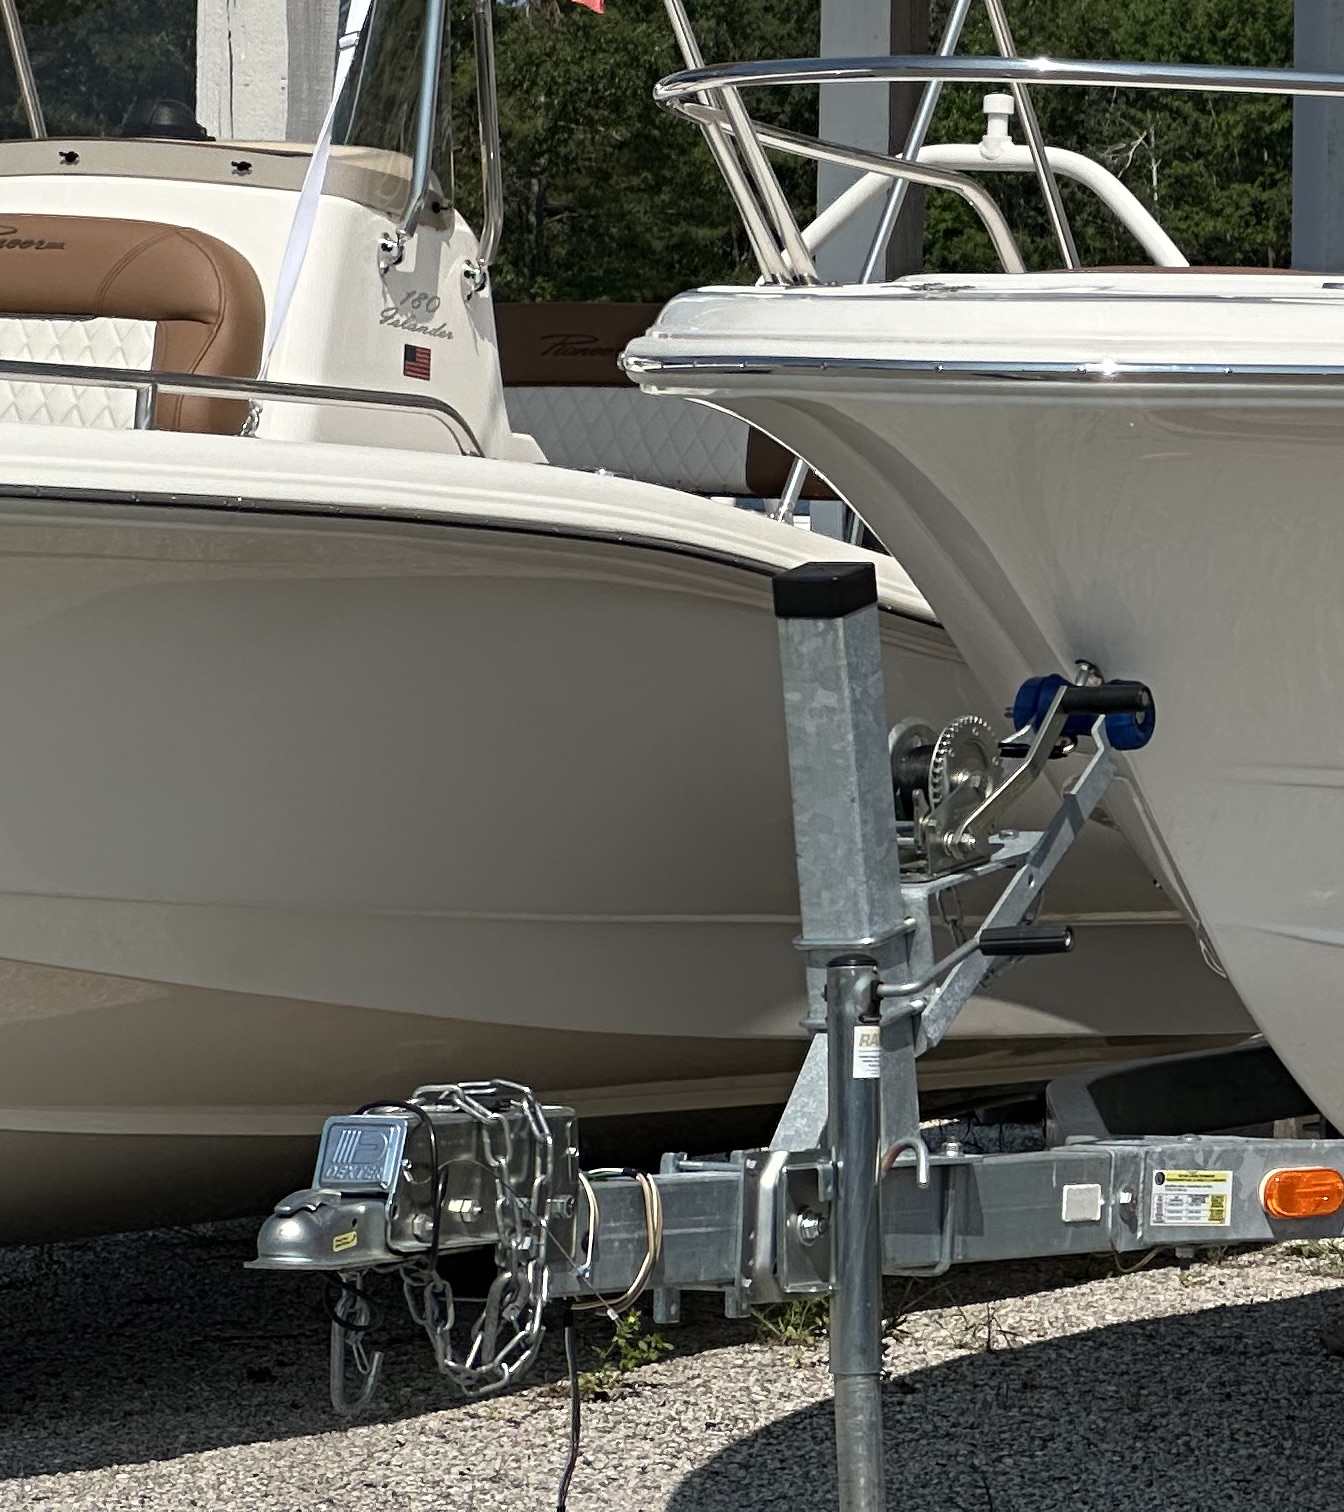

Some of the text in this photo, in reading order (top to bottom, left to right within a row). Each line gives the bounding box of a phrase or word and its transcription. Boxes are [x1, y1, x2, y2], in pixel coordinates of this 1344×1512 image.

[400, 290, 440, 313] 180
[379, 307, 454, 340] Islander
[858, 1033, 880, 1047] RA
[324, 1164, 384, 1180] DEXTER
